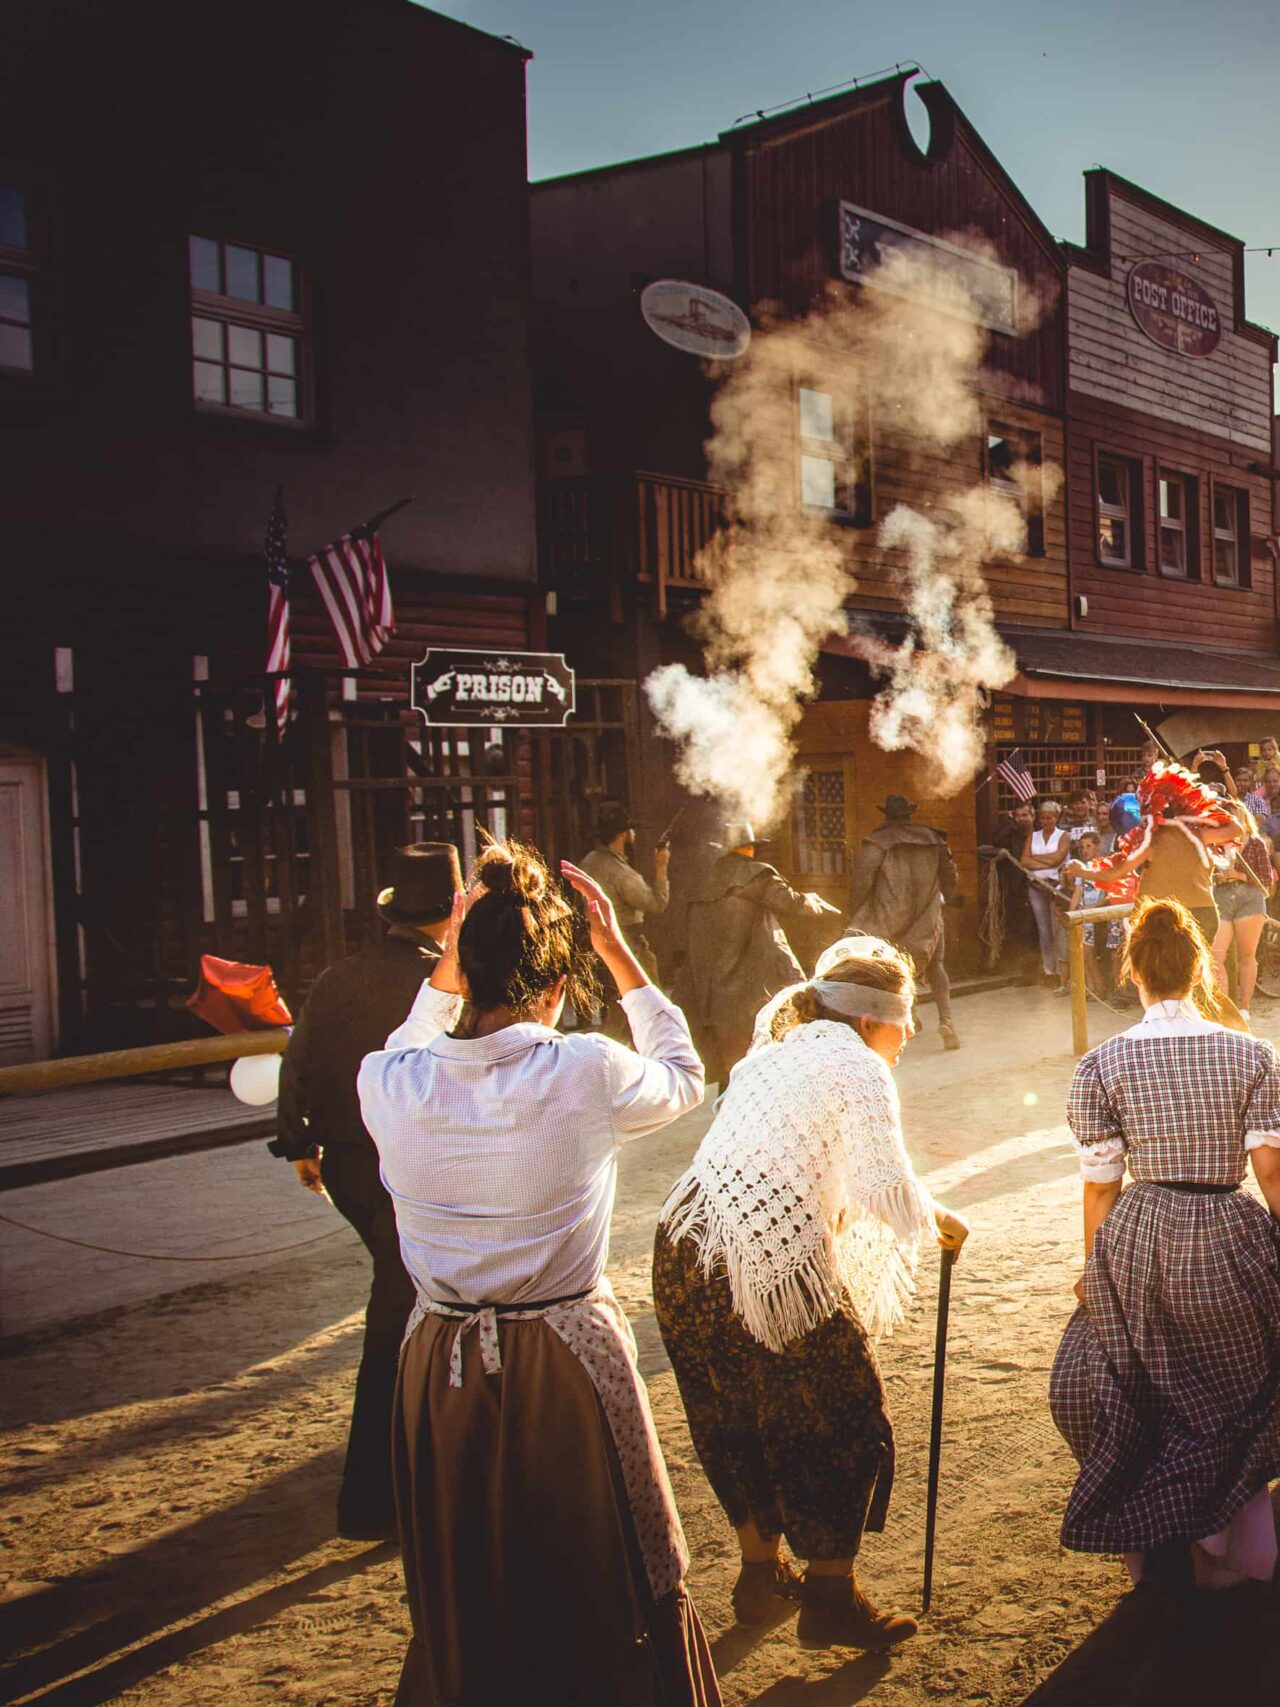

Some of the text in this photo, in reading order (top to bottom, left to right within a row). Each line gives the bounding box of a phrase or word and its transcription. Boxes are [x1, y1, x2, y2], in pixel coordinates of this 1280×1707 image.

[1133, 276, 1167, 311] POST
[1171, 292, 1217, 332] OFFICE
[455, 674, 544, 703] PRISON
